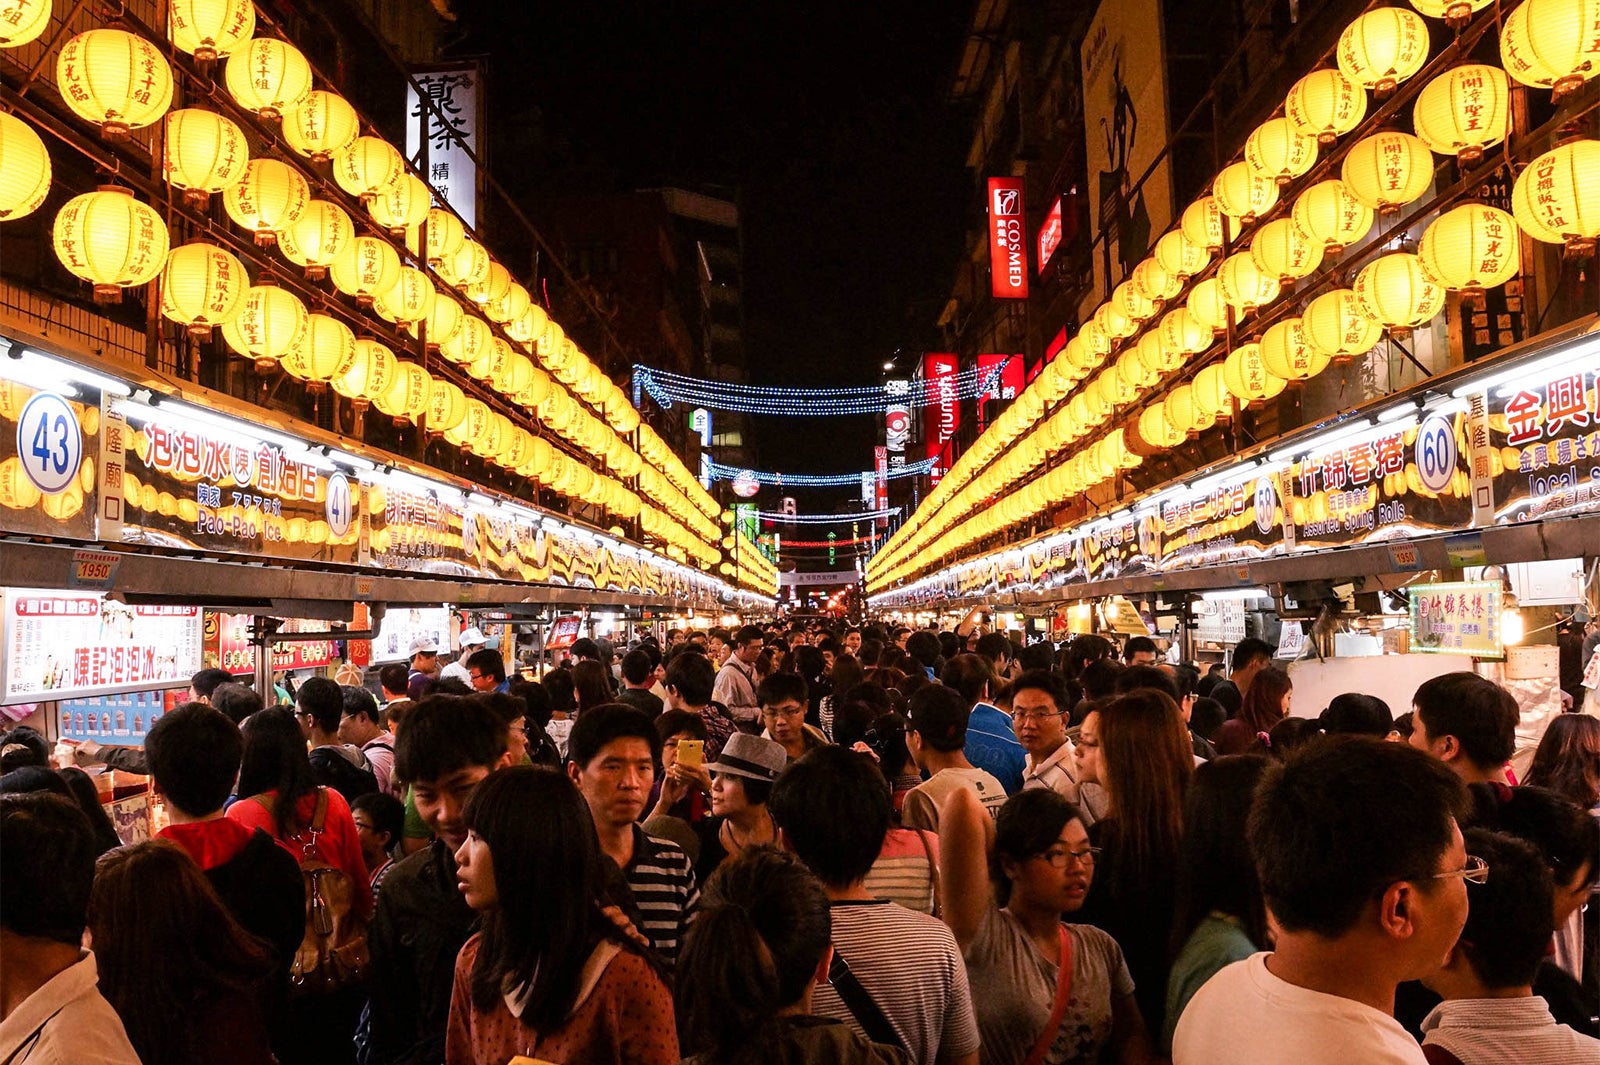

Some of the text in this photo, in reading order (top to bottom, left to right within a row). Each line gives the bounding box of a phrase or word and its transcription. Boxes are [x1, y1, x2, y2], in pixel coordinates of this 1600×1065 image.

[1007, 219, 1023, 287] COSMED
[1480, 211, 1504, 274] 歡迎光臨
[32, 411, 70, 475] 43
[144, 420, 229, 481] 泡泡冰
[257, 441, 318, 500] 創始店
[1300, 432, 1405, 498] 什錦春捲
[1422, 427, 1449, 478] 60
[1528, 466, 1578, 497] local
[197, 512, 282, 541] Pao-Pao Ice
[330, 483, 348, 528] 41
[1258, 486, 1273, 525] 58
[1302, 501, 1405, 538] Assorted Spring Rolls
[81, 563, 109, 578] 1950
[1396, 551, 1415, 563] 1950
[74, 644, 156, 688] 陳記泡泡冰
